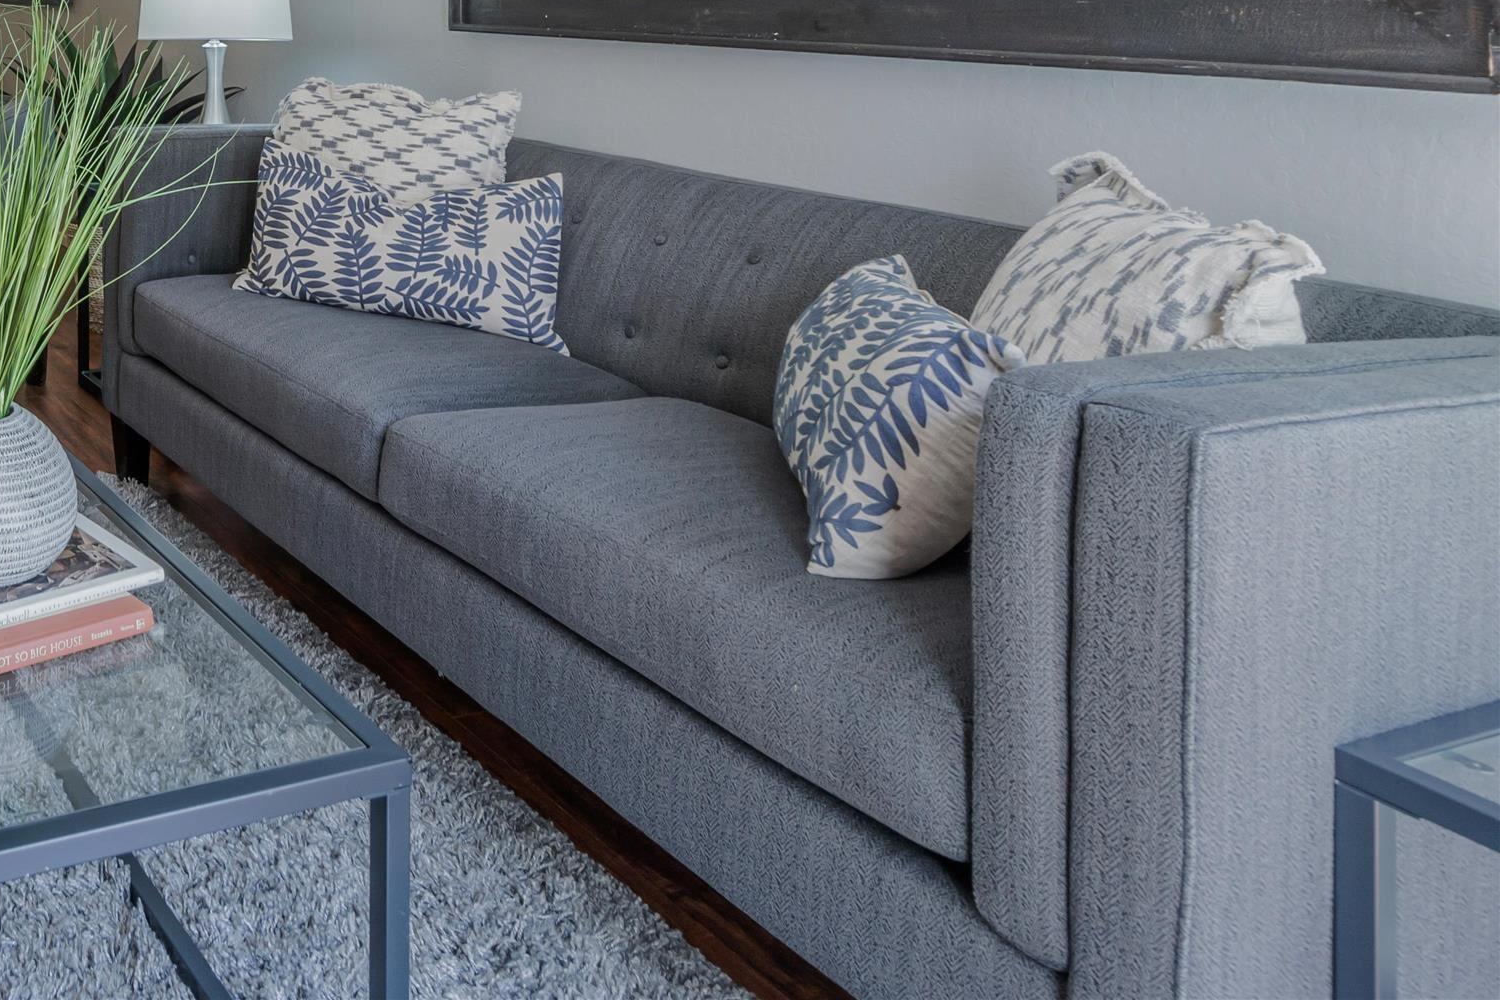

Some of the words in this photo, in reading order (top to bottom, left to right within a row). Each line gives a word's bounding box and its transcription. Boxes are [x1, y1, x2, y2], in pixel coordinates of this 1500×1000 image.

[15, 650, 29, 663] SO
[30, 645, 47, 659] BIG
[50, 635, 83, 653] HOUSE
